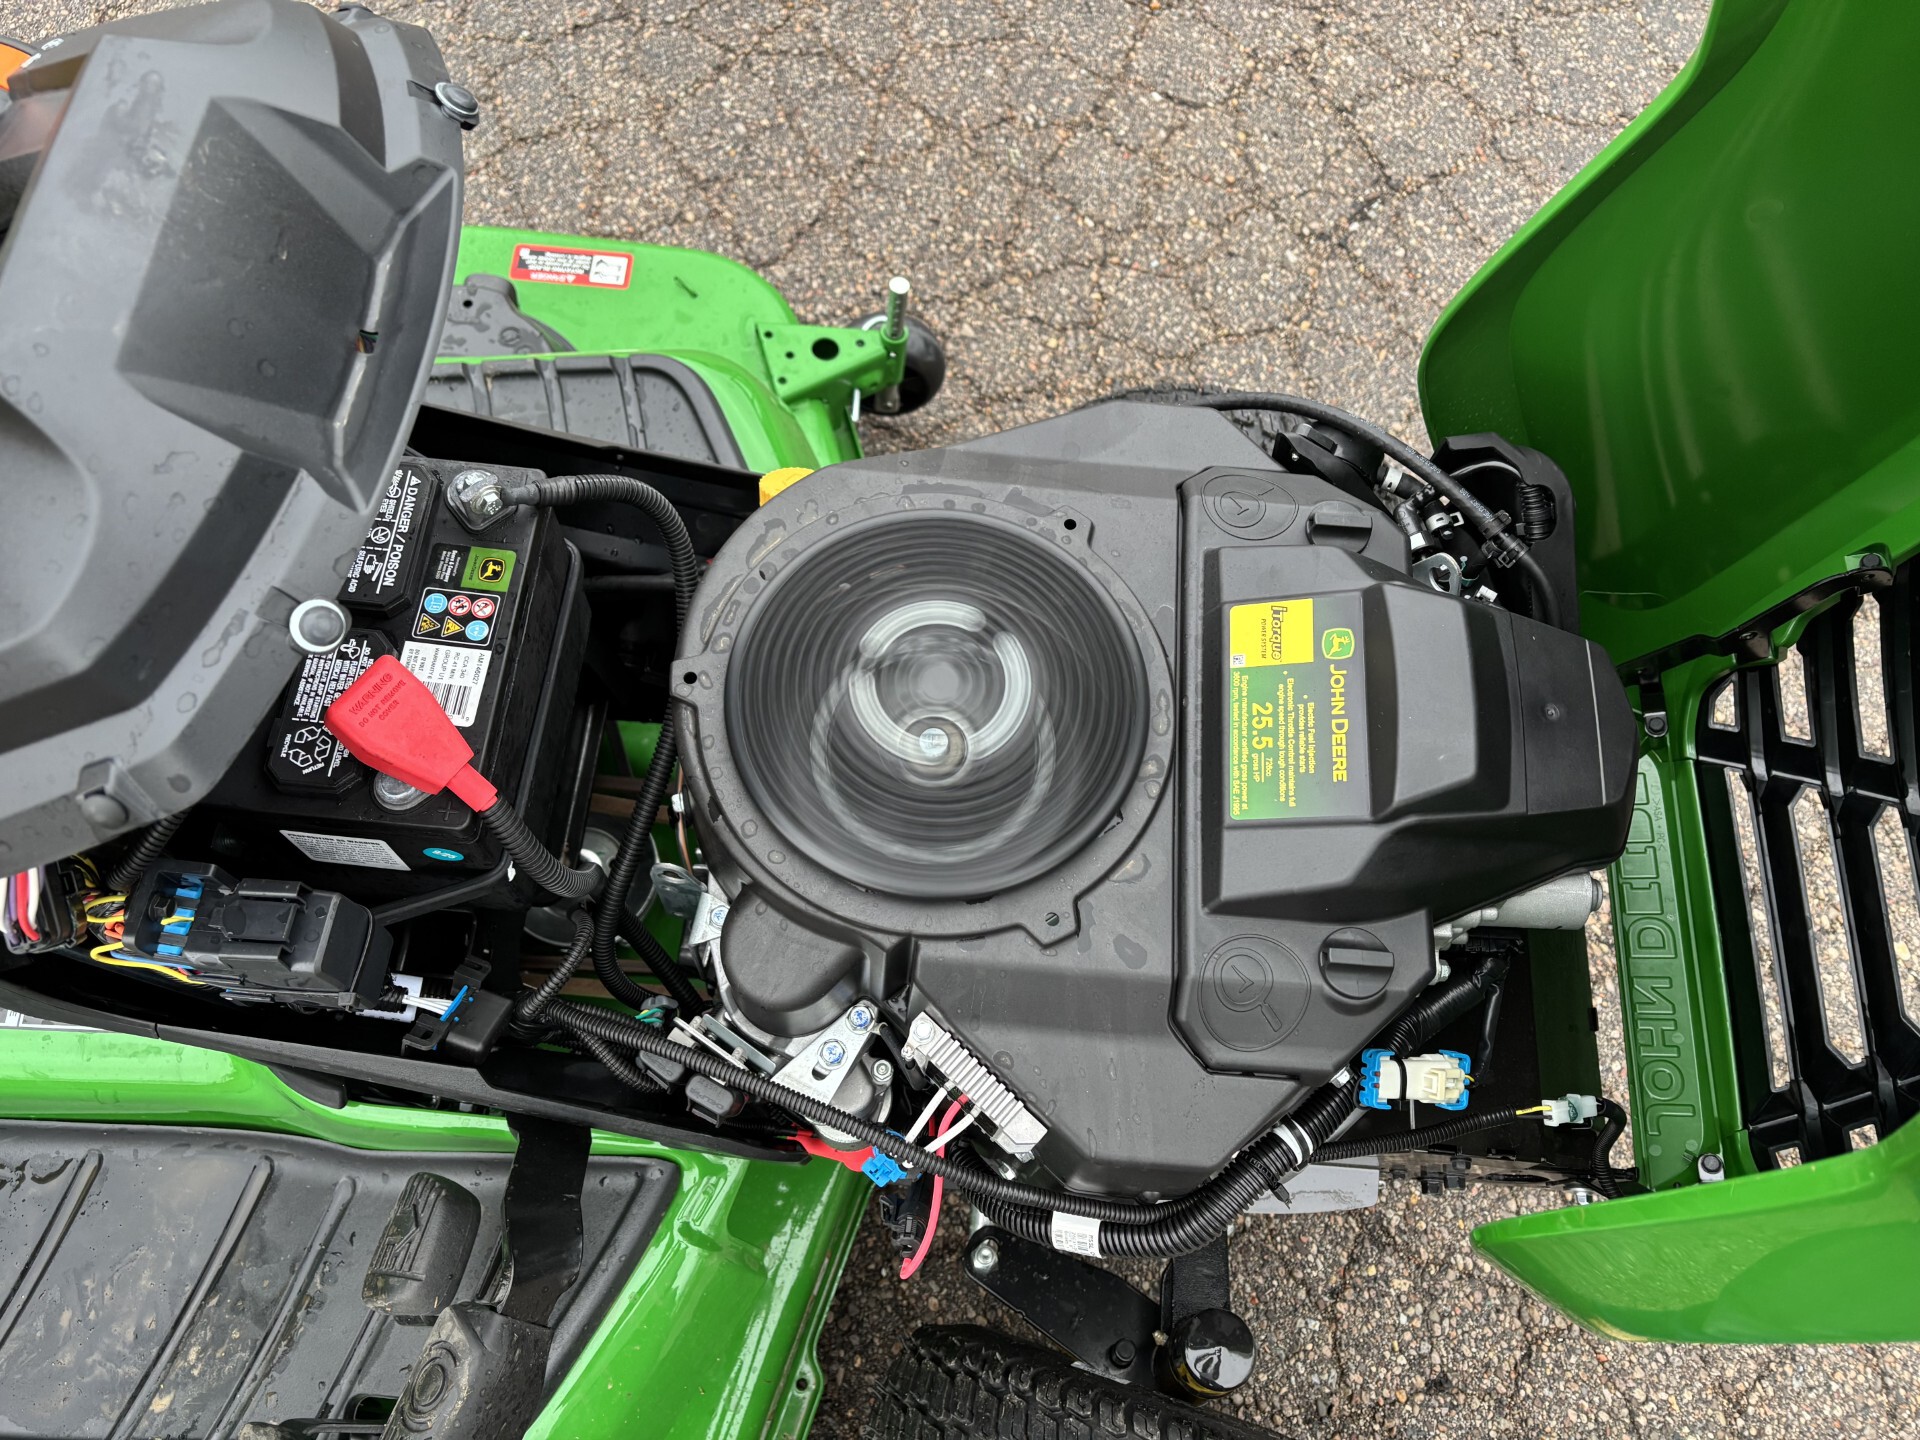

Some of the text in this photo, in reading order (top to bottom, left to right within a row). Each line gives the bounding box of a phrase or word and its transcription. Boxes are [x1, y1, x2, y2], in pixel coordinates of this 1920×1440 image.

[379, 498, 389, 513] EYES
[384, 499, 397, 519] SHIELD
[397, 487, 418, 534] DANGER
[352, 550, 366, 578] SULFURIC
[383, 544, 404, 587] POISON
[347, 578, 358, 593] ACID
[361, 656, 369, 667] NOT
[364, 647, 371, 656] DO
[429, 647, 439, 675] WARRANTY
[454, 652, 460, 660] RC
[342, 660, 350, 673] WITH
[344, 661, 358, 689] FLUSH EYES
[438, 649, 450, 681] GROUP U1
[324, 659, 342, 707] MEDICAL HELP FAST
[1232, 671, 1240, 686] 3600
[1240, 675, 1249, 696] Engine
[297, 694, 308, 718] AVAILABLE
[348, 672, 393, 716] WARNING
[358, 679, 407, 728] DO NOT REMOVE
[310, 696, 321, 719] STARTING
[378, 700, 399, 721] COVER
[1232, 702, 1240, 721] tested
[1240, 697, 1249, 737] manufacturer
[1297, 704, 1306, 729] provides
[1250, 702, 1274, 750] 25.5
[1329, 664, 1350, 782] JOHN DEERE
[280, 733, 291, 758] RECYCLE
[1232, 729, 1241, 763] accordance
[1276, 684, 1287, 802] engine speed through tough conditions
[1286, 678, 1296, 807] Electronic Throttle Control maintains full
[1298, 731, 1306, 754] reliable
[1306, 702, 1316, 773] Electric Fuel Injection
[1241, 739, 1249, 763] certified
[302, 762, 324, 774] RETURN
[1240, 764, 1248, 781] gross
[1251, 753, 1259, 782] gross HP
[1232, 780, 1240, 794] SAE
[1240, 782, 1248, 802] power
